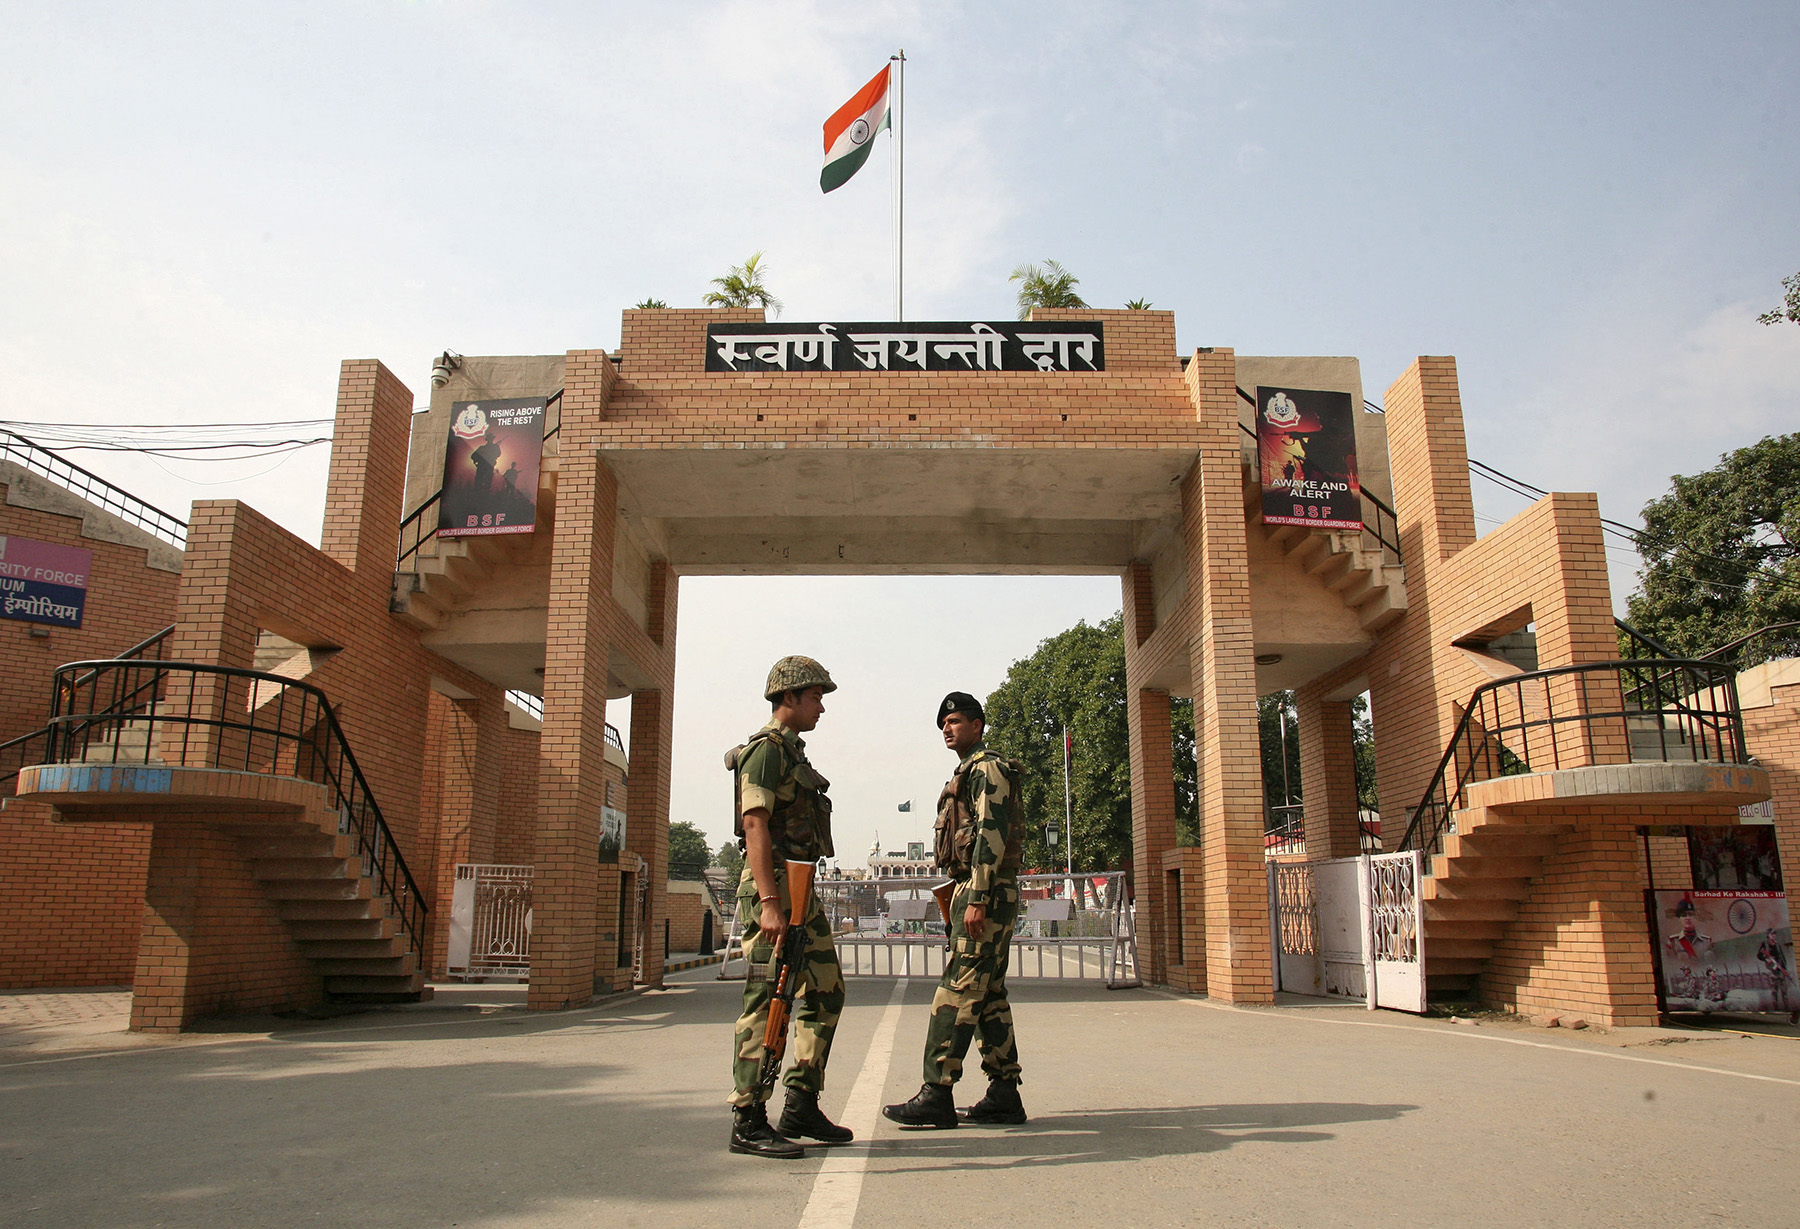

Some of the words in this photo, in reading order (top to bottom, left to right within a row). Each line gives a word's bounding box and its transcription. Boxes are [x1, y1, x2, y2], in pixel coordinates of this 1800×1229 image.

[710, 323, 840, 371] स्वर्ण
[846, 323, 1009, 371] जयन्ती
[1015, 333, 1101, 371] द्वार
[490, 408, 515, 418] RISING
[516, 406, 542, 416] ABOVE
[498, 417, 512, 426] THE
[513, 416, 533, 425] REST
[1272, 478, 1318, 490] AWAKE
[1320, 481, 1348, 492] AND
[1290, 488, 1331, 500] ALERT
[1346, 521, 1361, 529] FORCE
[34, 567, 85, 586] FORCE
